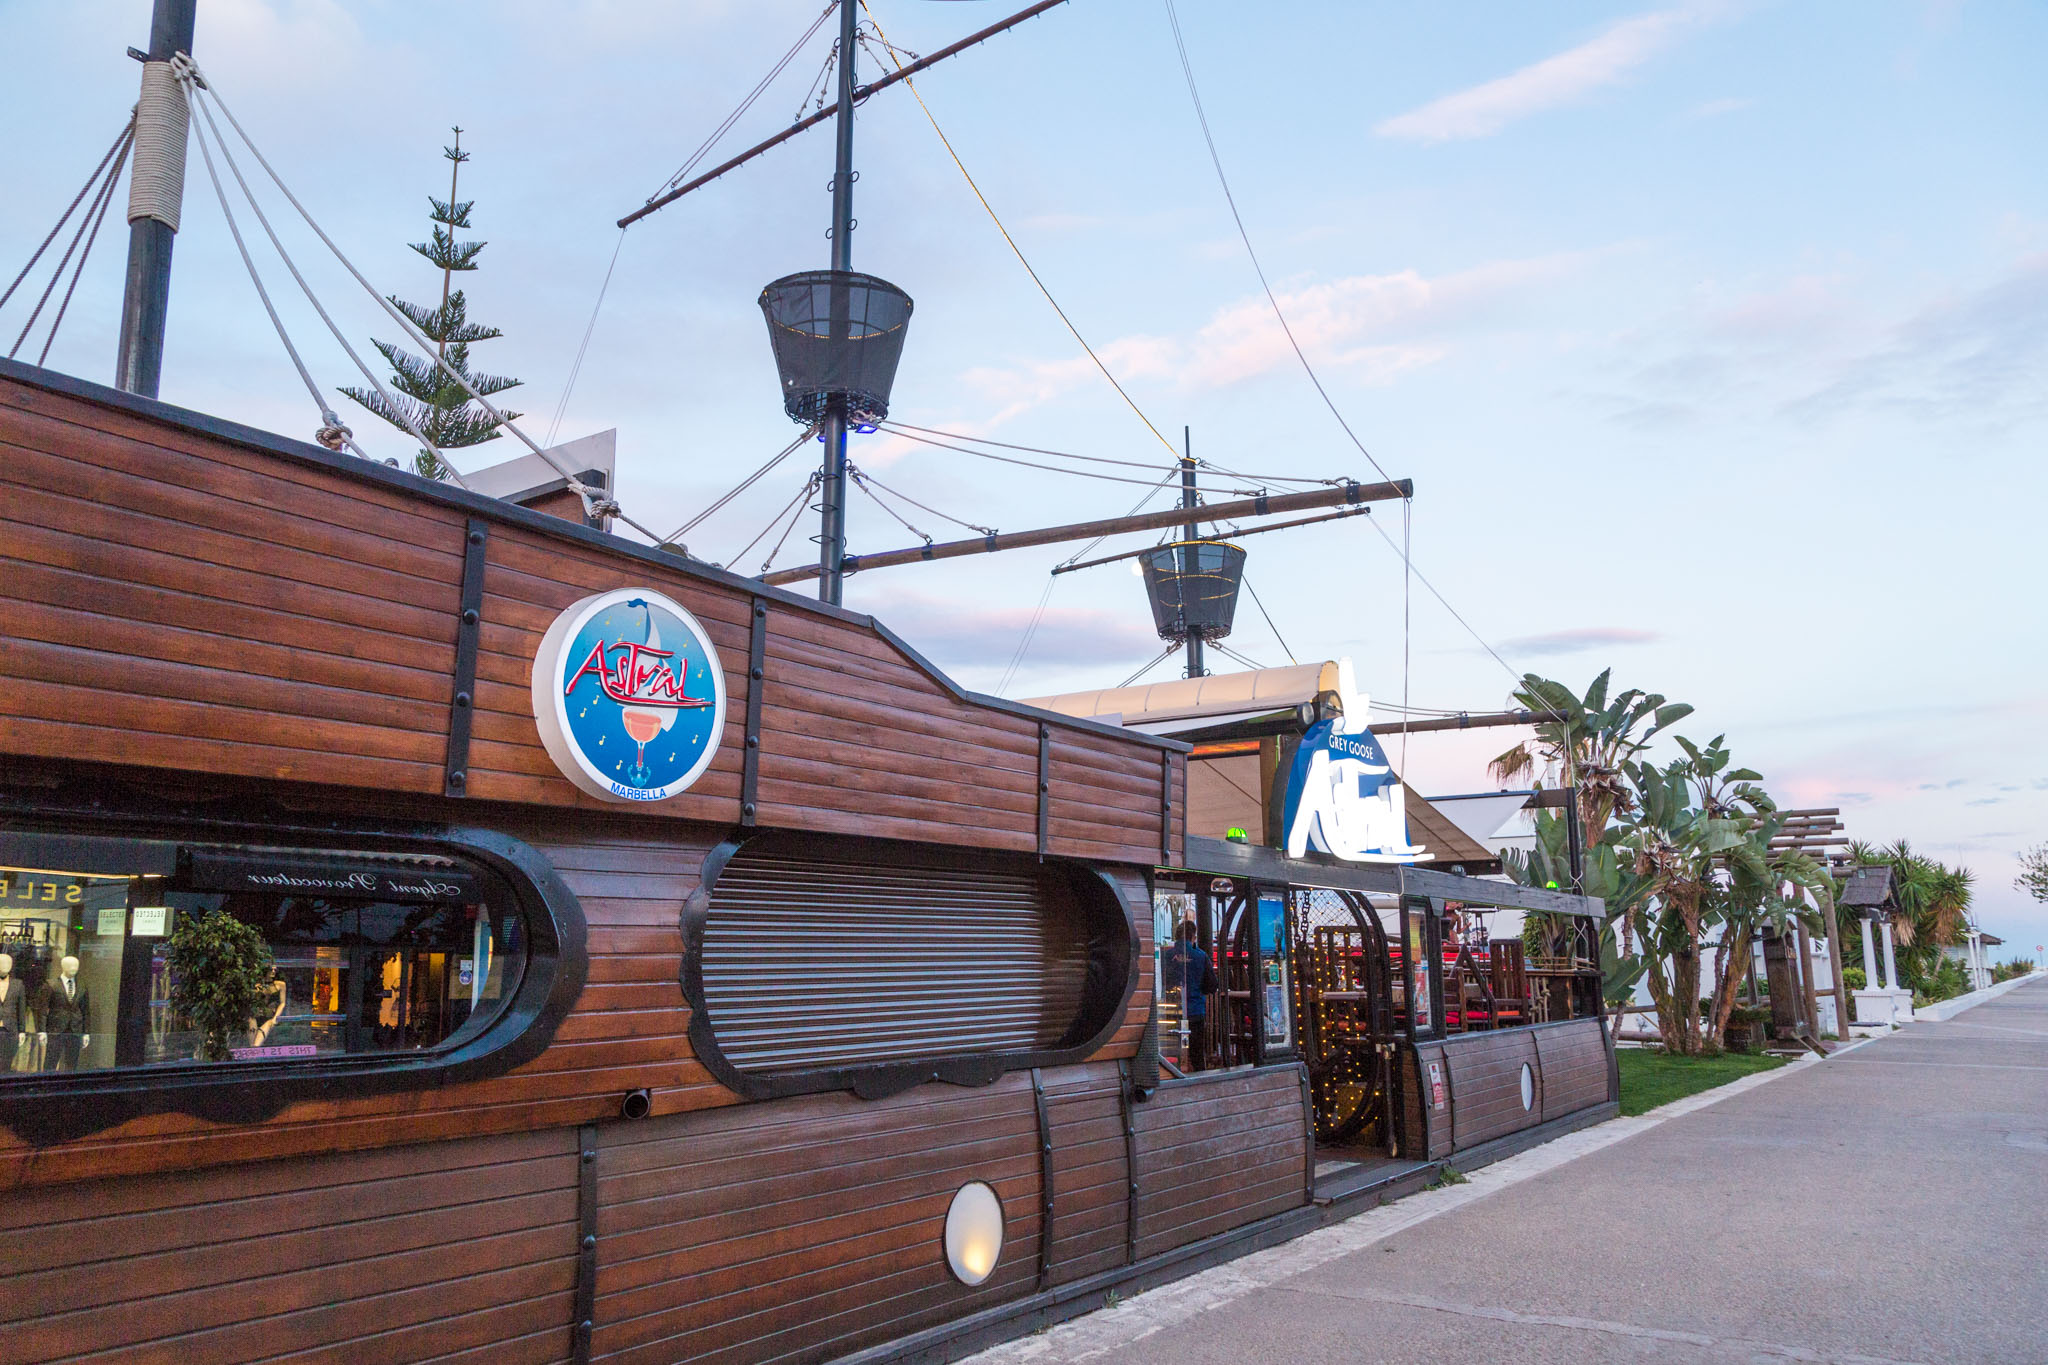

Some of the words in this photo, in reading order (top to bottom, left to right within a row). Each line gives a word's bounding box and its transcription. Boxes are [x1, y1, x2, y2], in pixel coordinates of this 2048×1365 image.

[1328, 734, 1348, 753] GREY
[1348, 741, 1374, 761] GOOSE
[610, 782, 667, 801] MARBELLA
[1288, 749, 1436, 864] Atl
